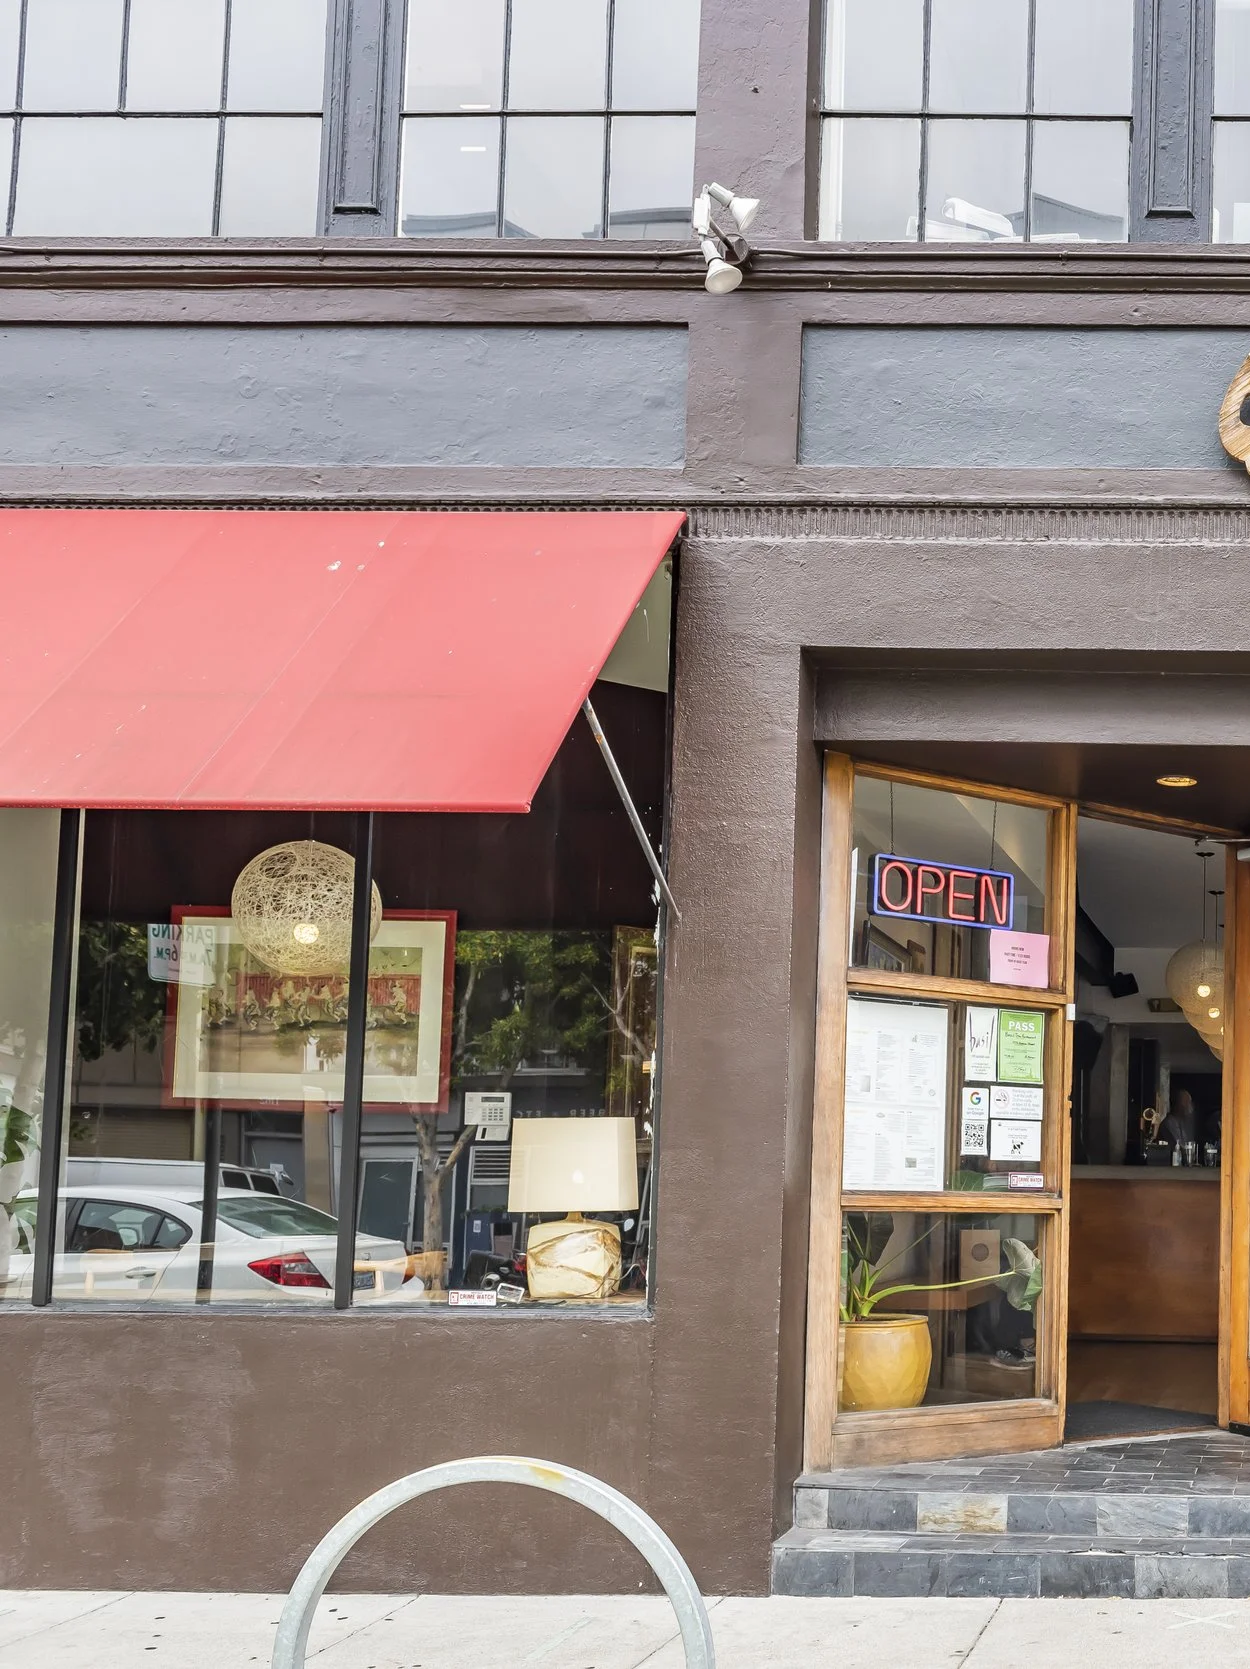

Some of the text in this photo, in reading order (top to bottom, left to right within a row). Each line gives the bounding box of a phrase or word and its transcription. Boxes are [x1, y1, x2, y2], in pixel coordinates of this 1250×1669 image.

[881, 861, 1008, 925] OPEN
[969, 1012, 995, 1054] basil
[1008, 1021, 1035, 1032] PASS
